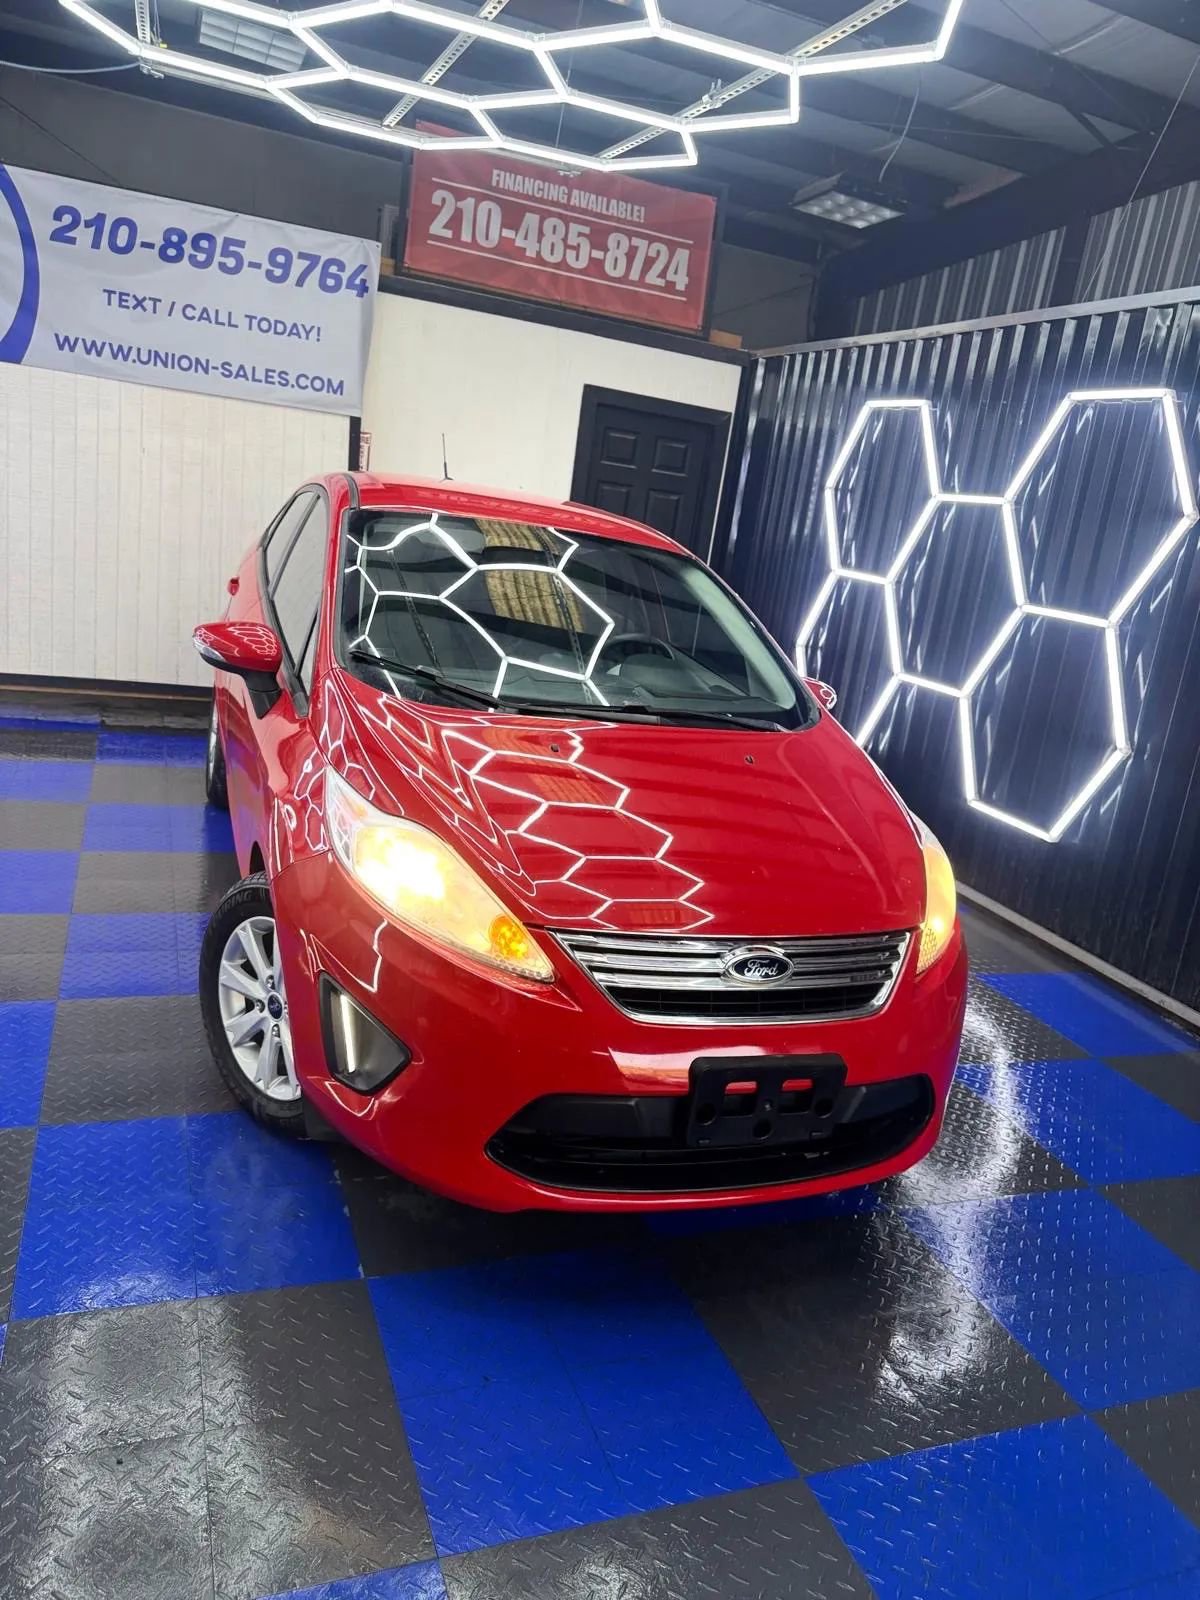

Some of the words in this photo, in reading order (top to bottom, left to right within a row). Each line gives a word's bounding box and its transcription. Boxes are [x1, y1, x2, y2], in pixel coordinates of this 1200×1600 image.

[491, 169, 568, 205] FINANCING
[570, 190, 645, 223] AVAILABLE!
[49, 204, 370, 299] 210-895-9764
[429, 189, 690, 292] 210-485-8724
[102, 288, 162, 315] TEXT
[167, 301, 176, 318] /
[181, 303, 239, 330] CALL
[244, 313, 322, 343] TODAY!
[54, 332, 346, 397] WWW.UNION-SALES.COM
[744, 959, 779, 977] Ford
